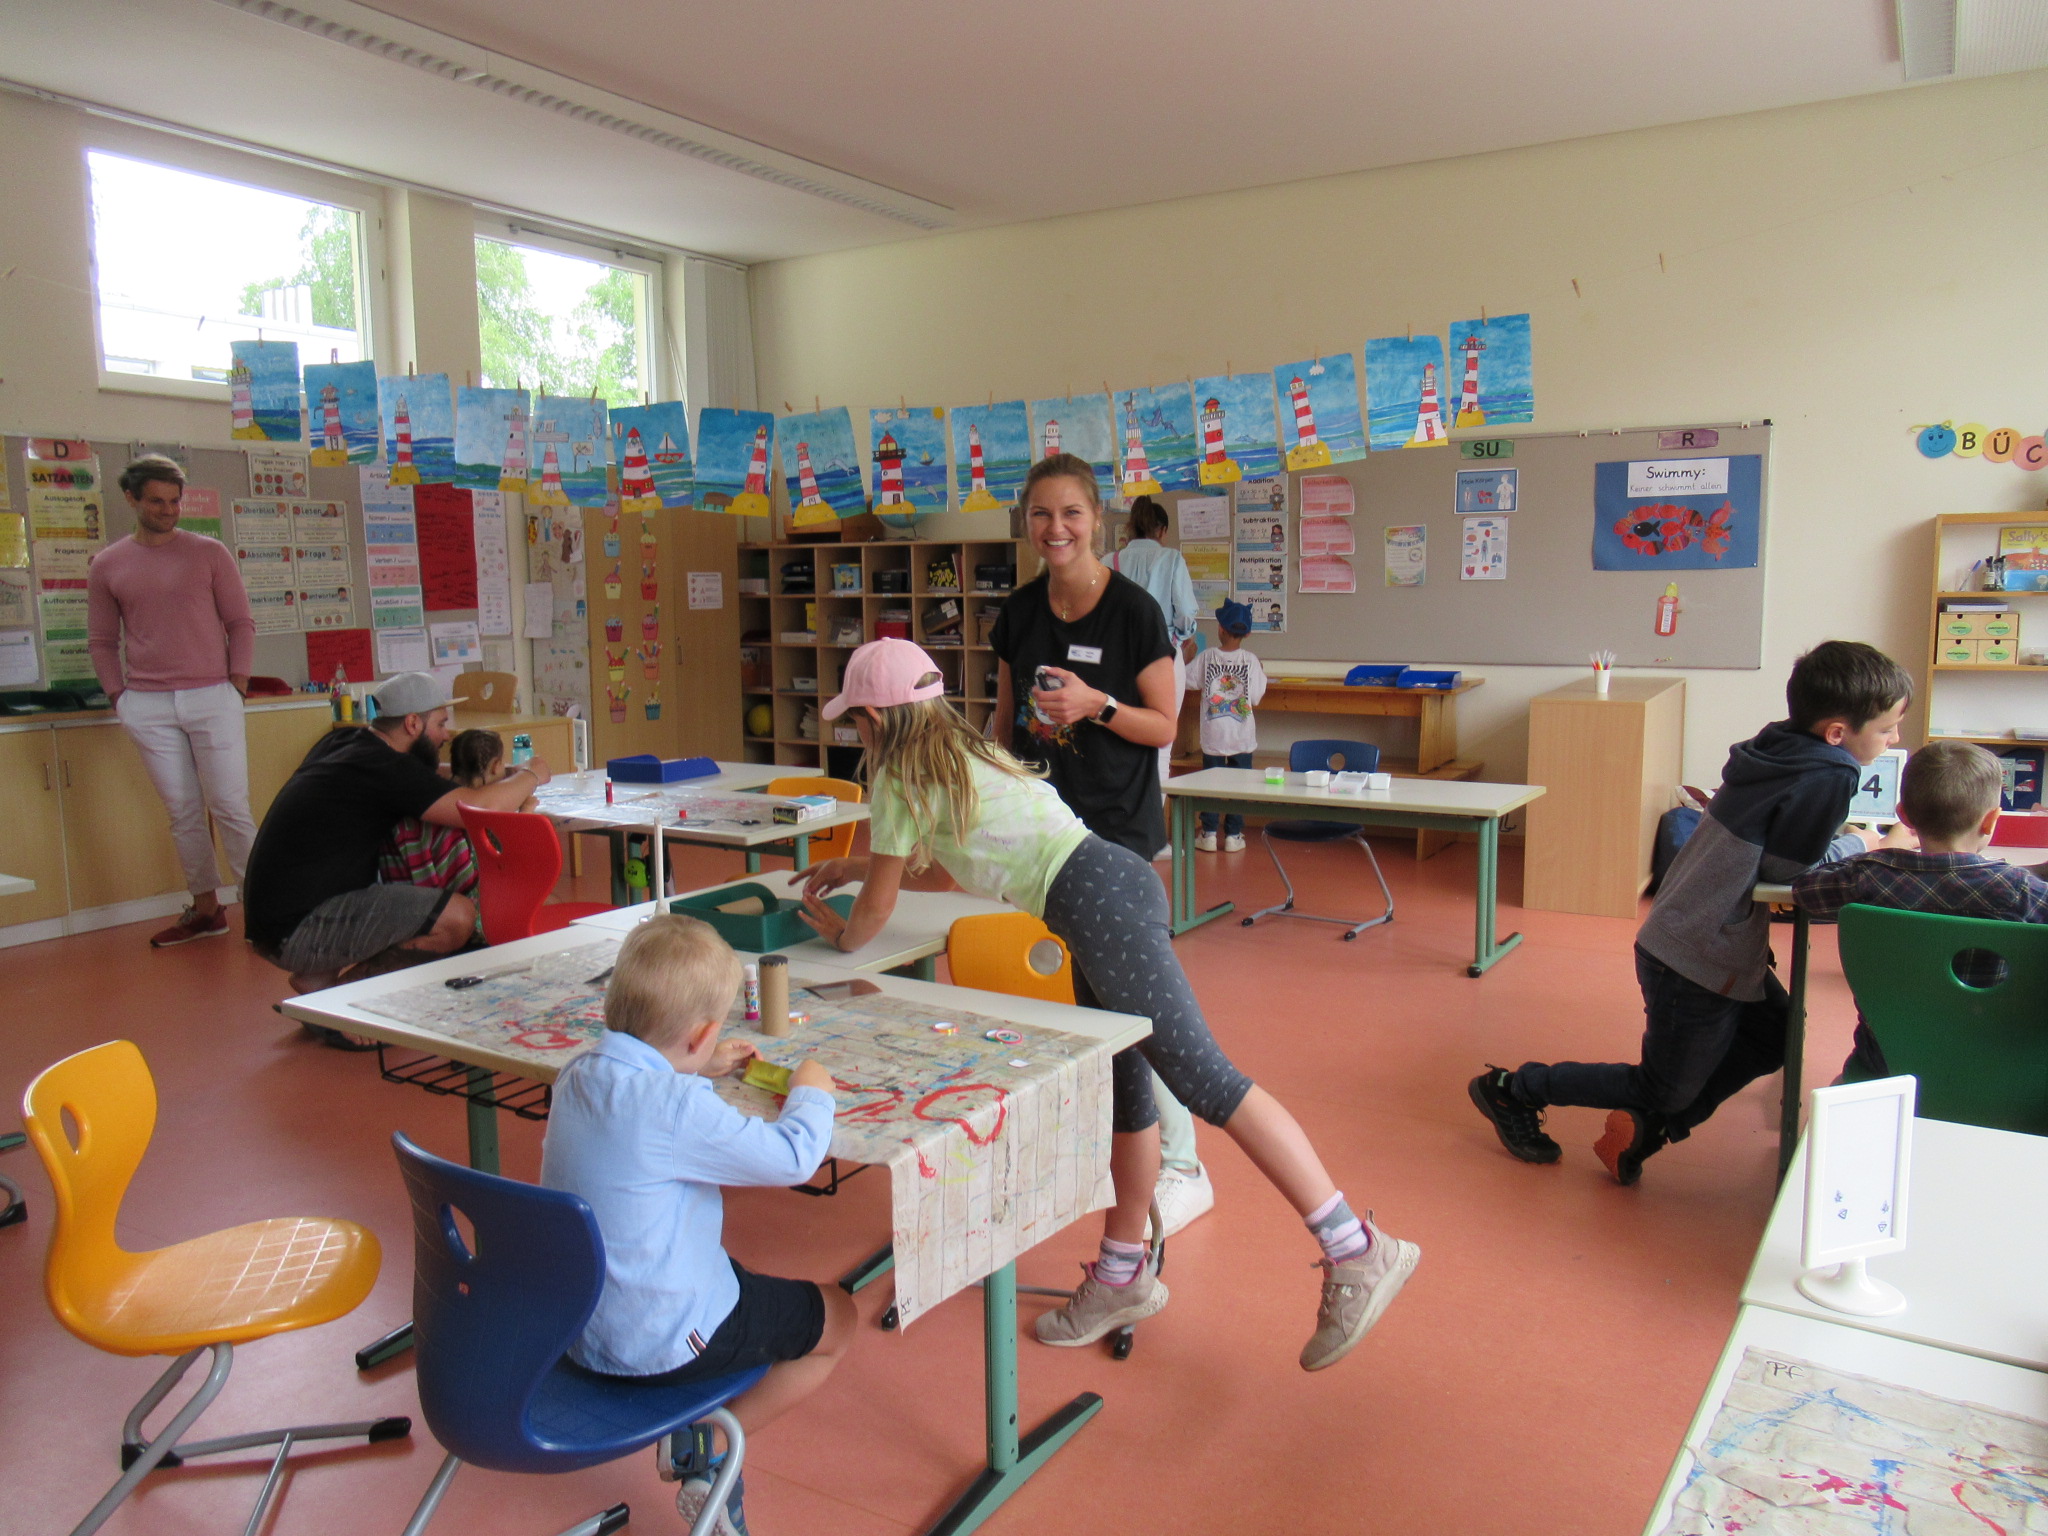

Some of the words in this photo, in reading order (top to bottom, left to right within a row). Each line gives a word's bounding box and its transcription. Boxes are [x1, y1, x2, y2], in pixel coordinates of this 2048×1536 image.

[1681, 432, 1695, 447] R
[53, 441, 70, 458] D
[1473, 441, 1500, 457] SU
[31, 471, 95, 484] SATZARTEN
[1645, 466, 1706, 480] Swimmy:
[1630, 485, 1653, 493] Keiner
[1658, 483, 1696, 492] schwimmt
[1700, 482, 1722, 490] allein
[243, 505, 275, 514] Überblick
[301, 506, 322, 514] Lesen
[2007, 530, 2048, 544] Sally's
[247, 550, 281, 558] Abschnitte
[304, 550, 327, 559] Frage
[1239, 557, 1282, 565] Multiplikation
[251, 595, 284, 603] markieren
[1860, 773, 1883, 799] 4
